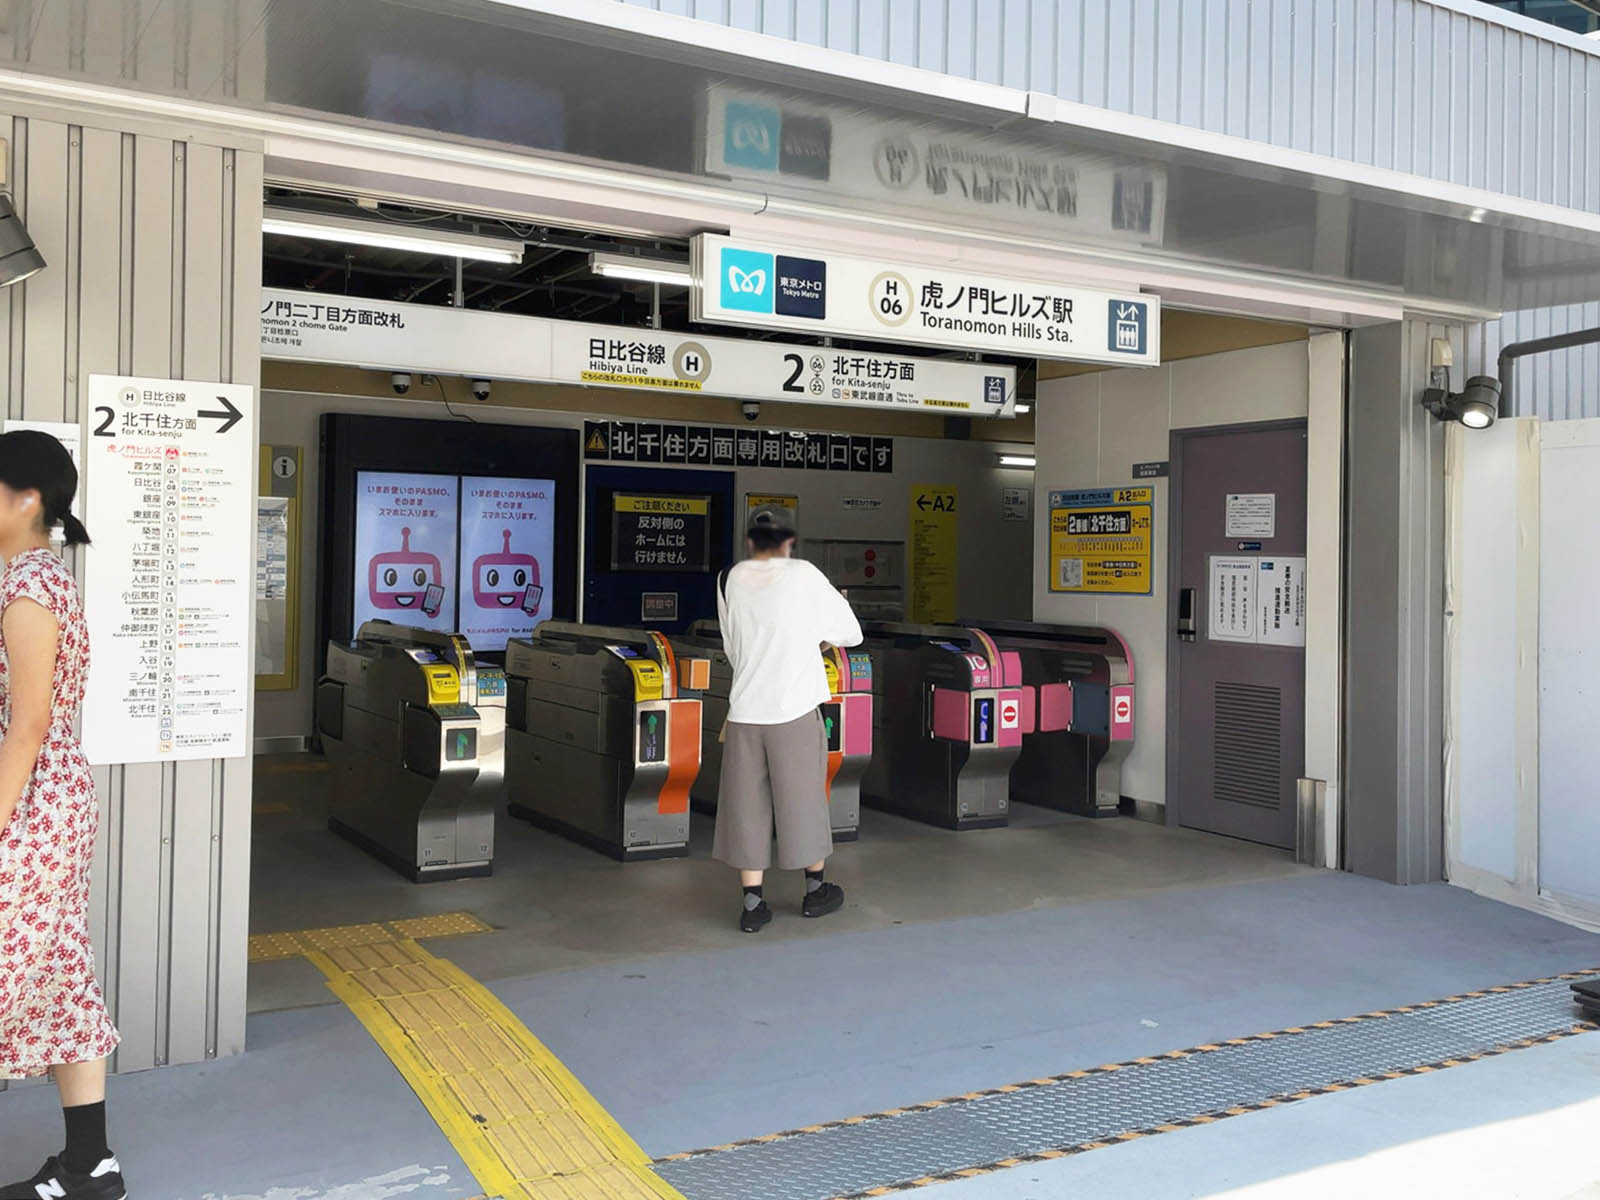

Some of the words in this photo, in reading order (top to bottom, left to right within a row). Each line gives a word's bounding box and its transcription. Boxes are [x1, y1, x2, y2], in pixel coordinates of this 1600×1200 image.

[780, 276, 822, 291] 東京メトロ
[886, 280, 898, 296] H
[782, 288, 800, 298] Tokyo
[801, 290, 819, 299] Metro
[880, 297, 902, 316] 06
[920, 280, 1073, 324] 虎ノ門ヒルズ駅
[261, 300, 405, 329] ノ門二丁目方面改札
[292, 319, 297, 327] 2
[299, 320, 326, 330] chome
[328, 323, 348, 332] Gate
[920, 311, 1007, 336] Toranomon
[1012, 319, 1042, 340] Hills
[1047, 326, 1073, 343] Sta.
[589, 338, 666, 365] 日比谷線
[590, 361, 623, 375] Hibiya
[626, 363, 648, 375] Line
[686, 356, 699, 372] H
[812, 361, 823, 370] 06
[832, 356, 915, 381] 北千住方面
[782, 353, 805, 393] 2
[832, 377, 846, 386] for
[848, 378, 891, 390] Kita-senju
[126, 393, 134, 401] H
[143, 390, 186, 402] 日比谷線
[93, 406, 116, 437] 2
[122, 411, 197, 430] 北千住方面
[121, 428, 134, 436] for
[138, 429, 182, 439] Kita-senju
[107, 444, 162, 455] 虎ノ門ヒルズ
[612, 430, 892, 467] 北千住方面専用改札口です
[134, 478, 161, 487] 日比谷
[143, 494, 161, 503] 銀座
[394, 498, 423, 506] そのまま
[1118, 490, 1132, 502] A2
[496, 501, 523, 509] そのまま
[633, 498, 690, 512] ご注意ください
[932, 495, 955, 512] A2
[133, 510, 161, 519] 東銀座
[638, 516, 685, 531] 反対側の
[635, 534, 686, 547] ホームには
[634, 550, 687, 565] 行けません
[132, 575, 159, 584] 人形町
[121, 591, 159, 600] 小伝馬町
[139, 640, 158, 648] 上野
[139, 656, 157, 664] 入谷
[965, 655, 988, 671] IC
[129, 672, 157, 681] 三ノ輪
[128, 688, 156, 697] 南千住
[128, 704, 156, 714] 北千住
